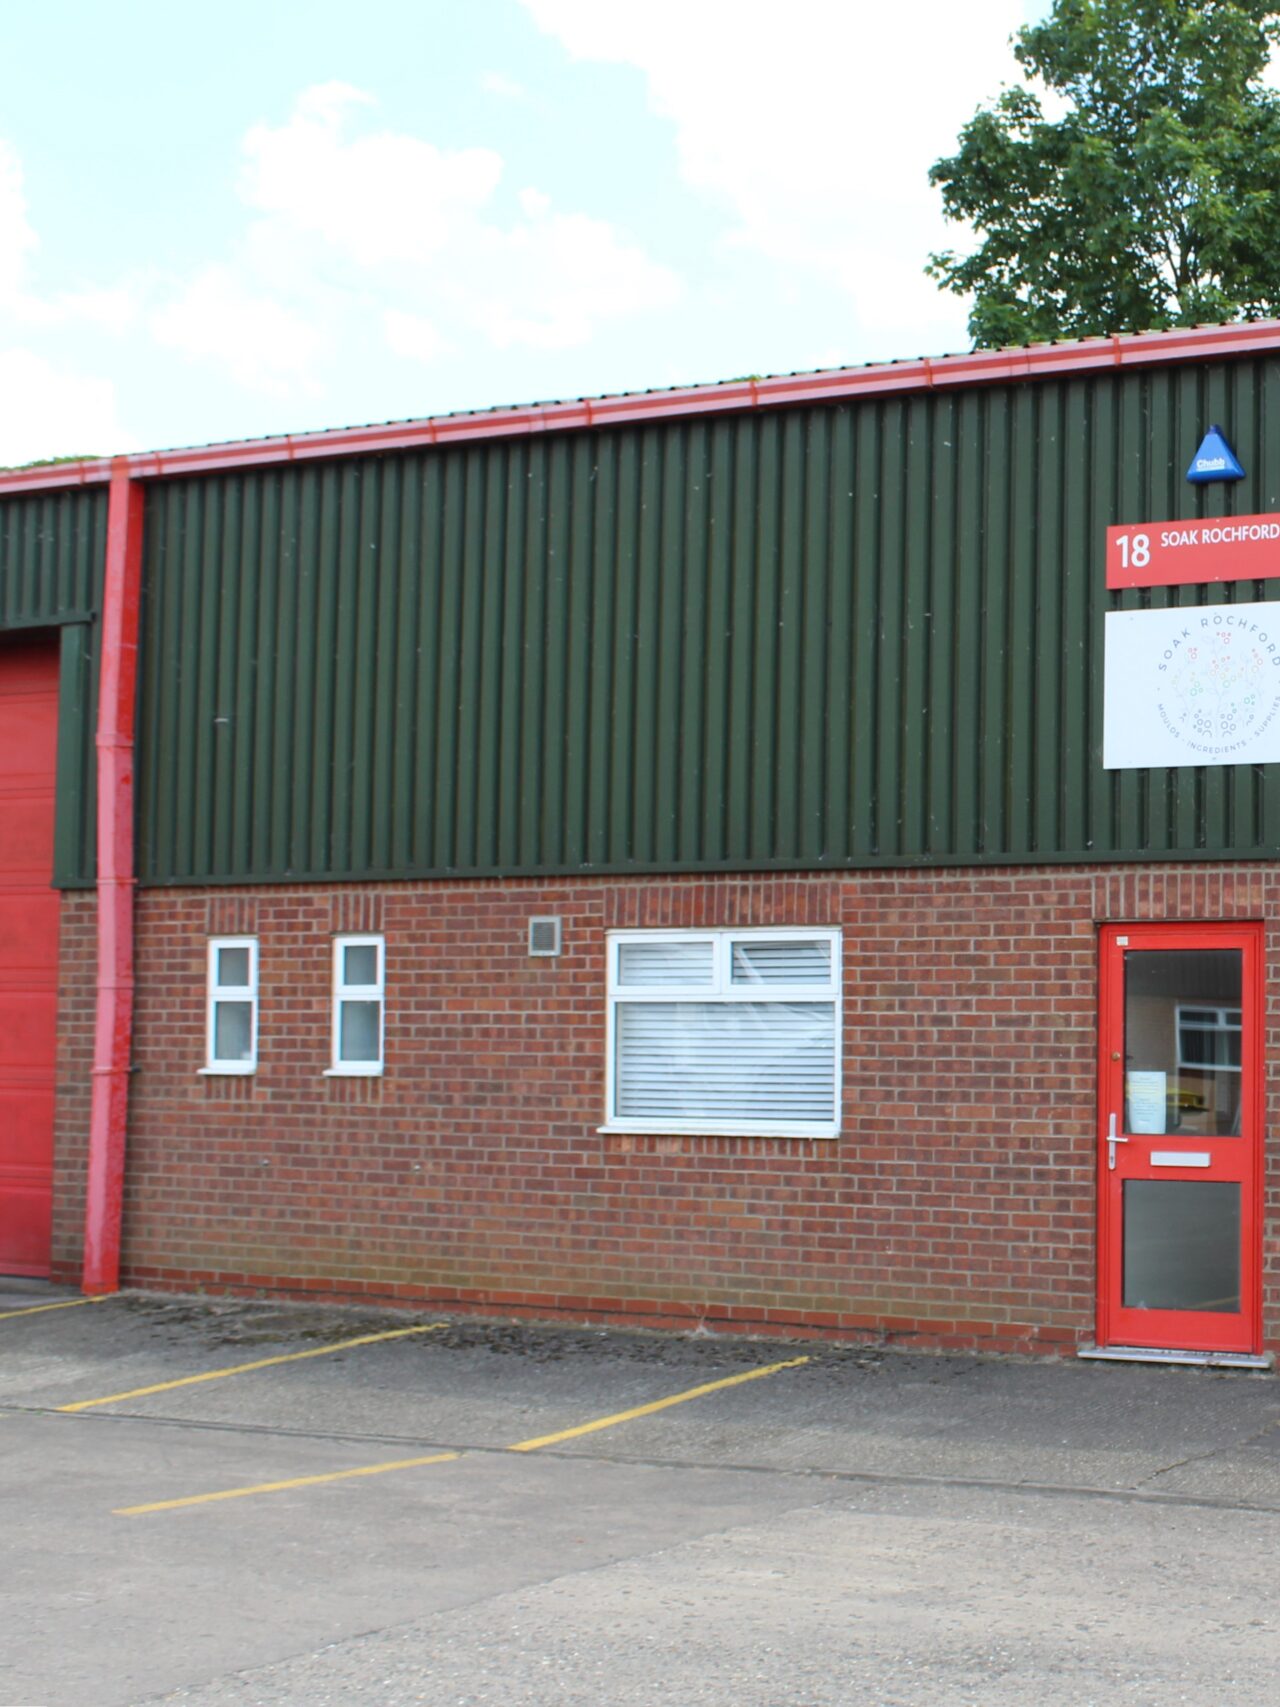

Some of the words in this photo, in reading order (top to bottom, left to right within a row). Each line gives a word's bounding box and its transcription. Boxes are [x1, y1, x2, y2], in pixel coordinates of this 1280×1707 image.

[1196, 457, 1225, 469] Chubb
[1160, 529, 1199, 547] SOAK
[1201, 523, 1280, 545] ROCHFORD
[1115, 533, 1151, 568] 18
[1158, 628, 1192, 672] SOAK
[1186, 740, 1247, 755] INGREDIENTS
